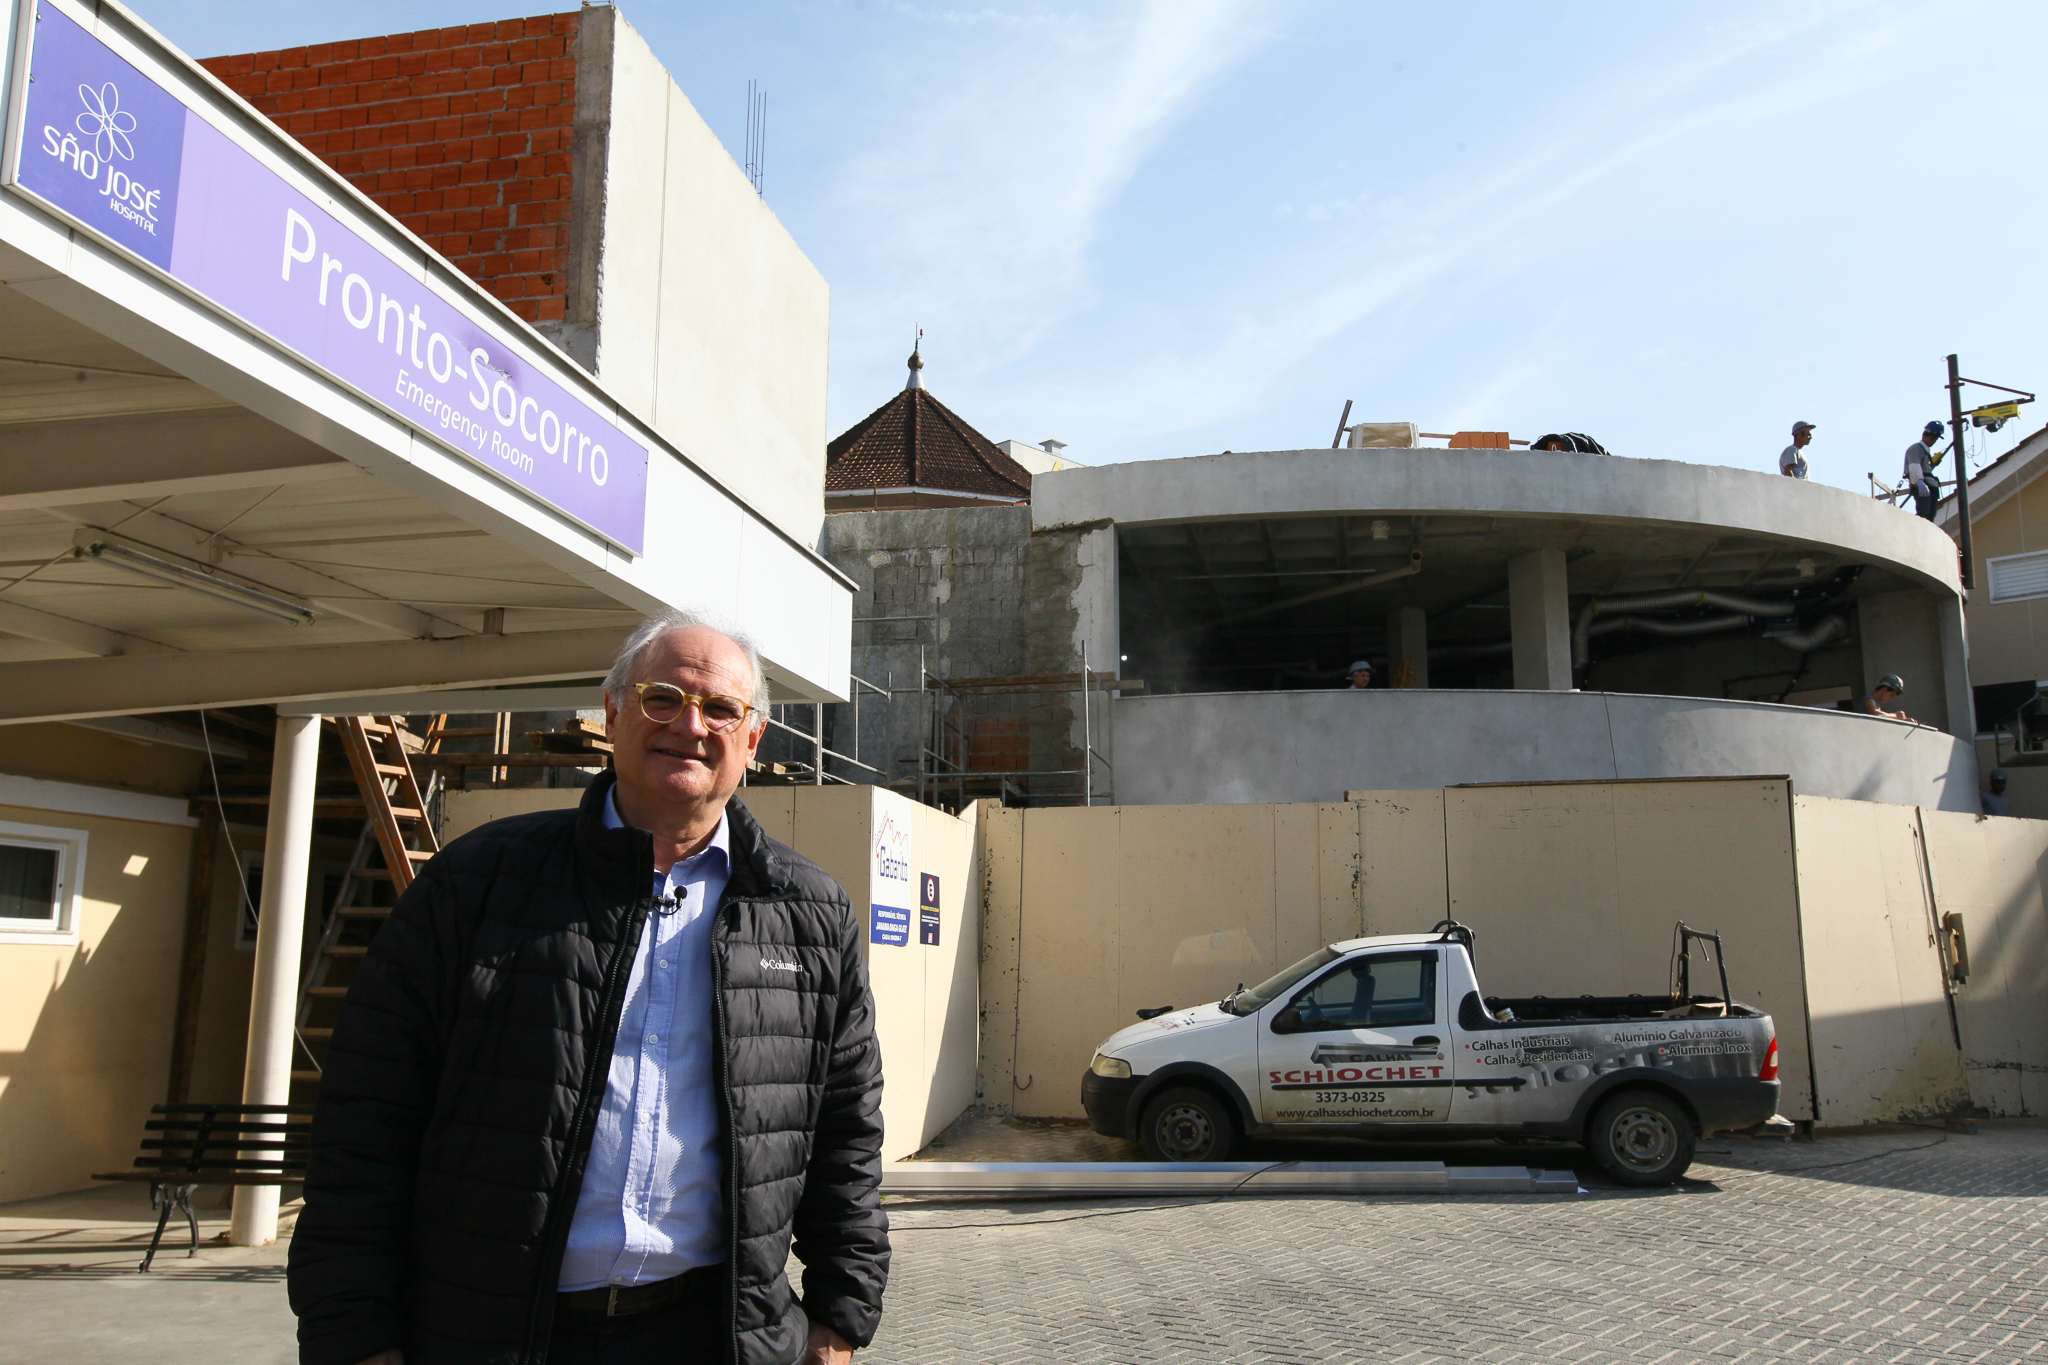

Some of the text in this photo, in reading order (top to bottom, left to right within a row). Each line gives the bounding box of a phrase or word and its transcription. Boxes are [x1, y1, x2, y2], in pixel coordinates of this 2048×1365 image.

[42, 125, 161, 222] SÃO JOSÉ
[110, 198, 157, 236] HOSPITAL
[281, 208, 609, 487] Pronto-Socorro
[395, 369, 534, 475] Emergency Room
[769, 959, 803, 972] Columbia
[1471, 1035, 1571, 1052] Calhas Industriais
[1613, 1028, 1742, 1043] Alumínio Galvanizado
[1667, 1043, 1723, 1056] Alumínio
[1724, 1043, 1752, 1054] Inox
[1350, 1053, 1412, 1063] CALHAS
[1484, 1050, 1594, 1066] Calhas Residenciais
[1268, 1065, 1445, 1084] SCHIOCHET
[1315, 1091, 1386, 1103] 3373-0325
[1276, 1107, 1435, 1119] www.calhasschiochet.com.br
